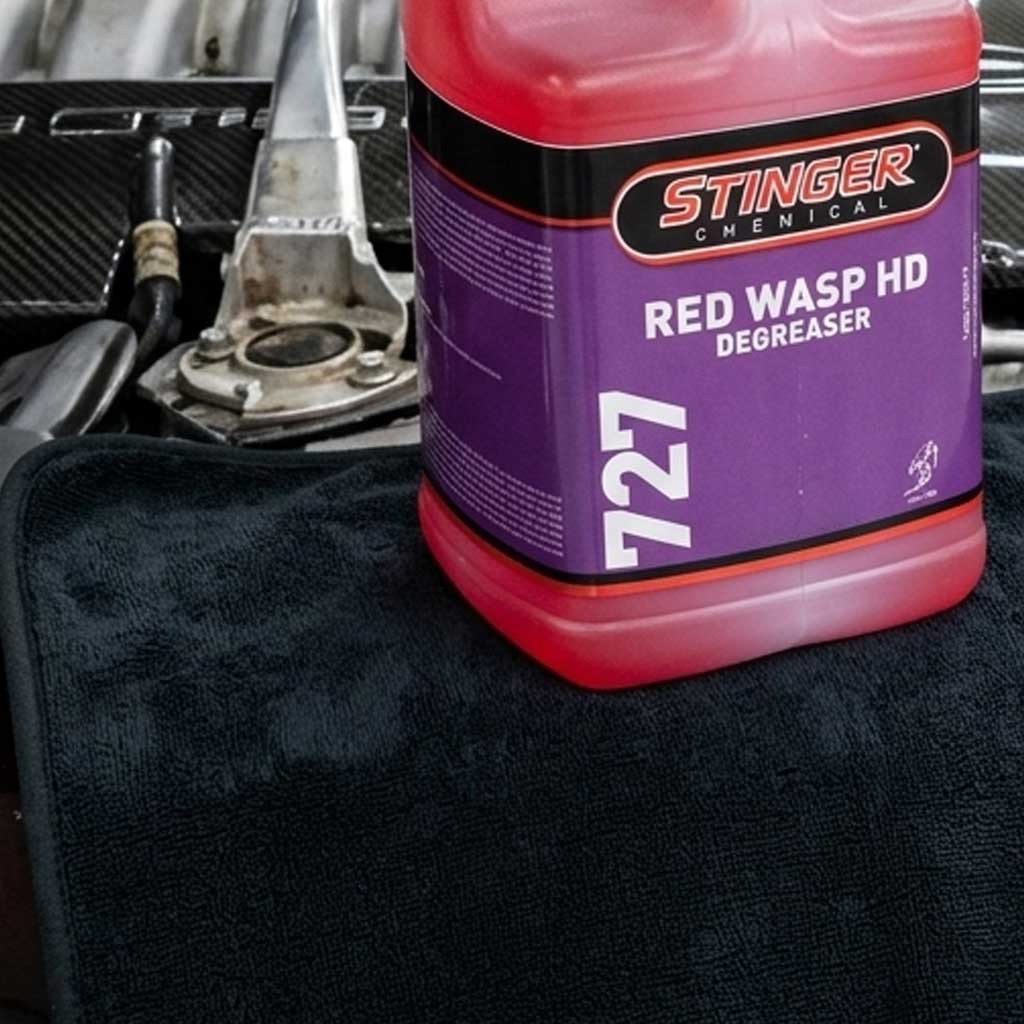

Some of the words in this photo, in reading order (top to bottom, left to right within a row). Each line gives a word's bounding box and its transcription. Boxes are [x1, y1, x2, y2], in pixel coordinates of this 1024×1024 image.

[660, 143, 915, 228] STINGER
[645, 291, 734, 339] RED
[746, 266, 866, 322] WASP
[877, 253, 928, 297] HD
[716, 306, 871, 357] DEGREASER
[598, 390, 692, 570] 727
